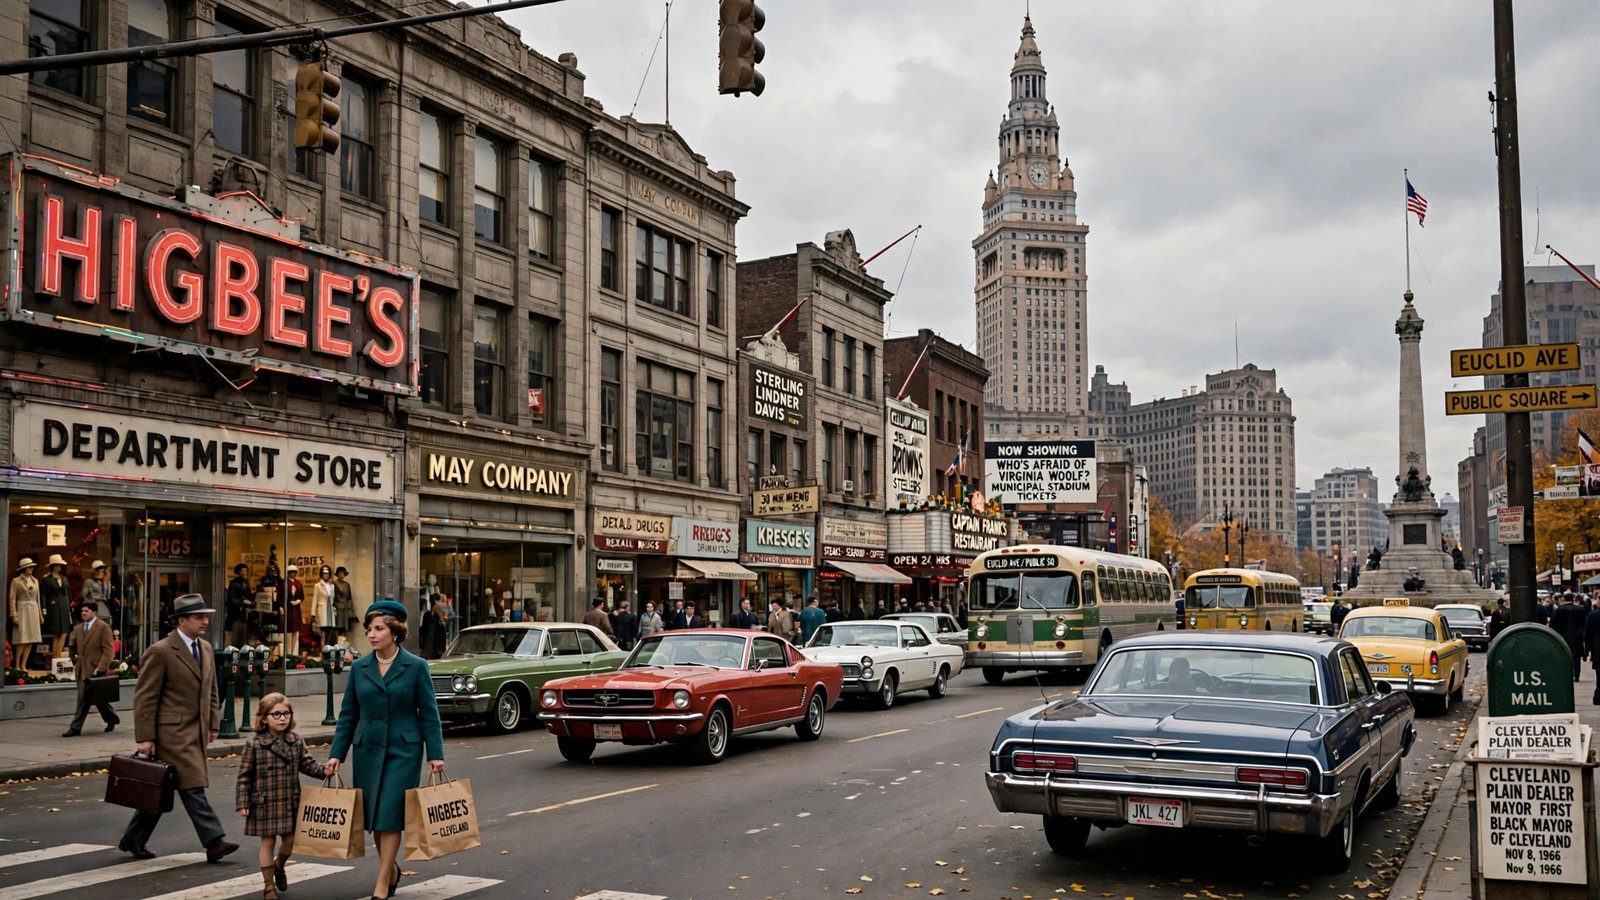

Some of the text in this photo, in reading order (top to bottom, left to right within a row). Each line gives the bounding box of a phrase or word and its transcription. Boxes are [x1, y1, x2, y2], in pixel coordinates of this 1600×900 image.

[35, 193, 406, 368] HIGBEE'S
[1459, 348, 1568, 371] EUCLID AVE
[755, 369, 804, 396] STERLING
[755, 384, 800, 410] LINDNER
[1452, 390, 1568, 411] PUBLIC SQUARE
[755, 400, 785, 421] DAVIS
[42, 418, 382, 489] DEPARTMENT STORE
[997, 445, 1078, 457] NOW SHOWING
[892, 443, 924, 480] BROWNS
[996, 459, 1087, 470] WHO'S AFRAID OF
[428, 453, 572, 496] MAY COMPANY
[999, 470, 1090, 482] VIRGINIA WOOLF?
[991, 482, 1090, 492] MUNICIPAL STADIUM
[1017, 491, 1057, 500] TICKETS
[760, 494, 770, 504] 30
[636, 519, 665, 534] DRUGS
[952, 513, 1008, 537] CAPTAIN FRANK'S
[757, 526, 811, 549] KRESGE'S
[954, 532, 998, 551] RESTAURANT
[138, 538, 191, 556] DRUGS
[893, 555, 918, 565] OPEN
[986, 559, 1008, 569] EUCLID
[1513, 671, 1547, 686] U.S.
[1511, 692, 1553, 706] MAIL
[1495, 725, 1567, 737] CLEVELAND
[1489, 736, 1572, 748] PLAIN DEALER
[1489, 767, 1571, 784] CLEVELAND
[1486, 784, 1574, 802] PLAIN DEALER
[302, 805, 347, 826] HIGBEE'S
[427, 799, 469, 824] HIGBEE'S
[1132, 804, 1179, 821] JKL 427
[1490, 801, 1572, 818] MAYOR FIRST
[439, 821, 470, 838] CLEVELAND
[1490, 817, 1573, 833] BLACK MAYOR
[308, 827, 341, 841] CLEVELAND
[1490, 832, 1572, 849] OF CLEVELAND
[1505, 848, 1561, 862] NOV 8, 1966
[1506, 862, 1562, 876] Nov 9, 1966
